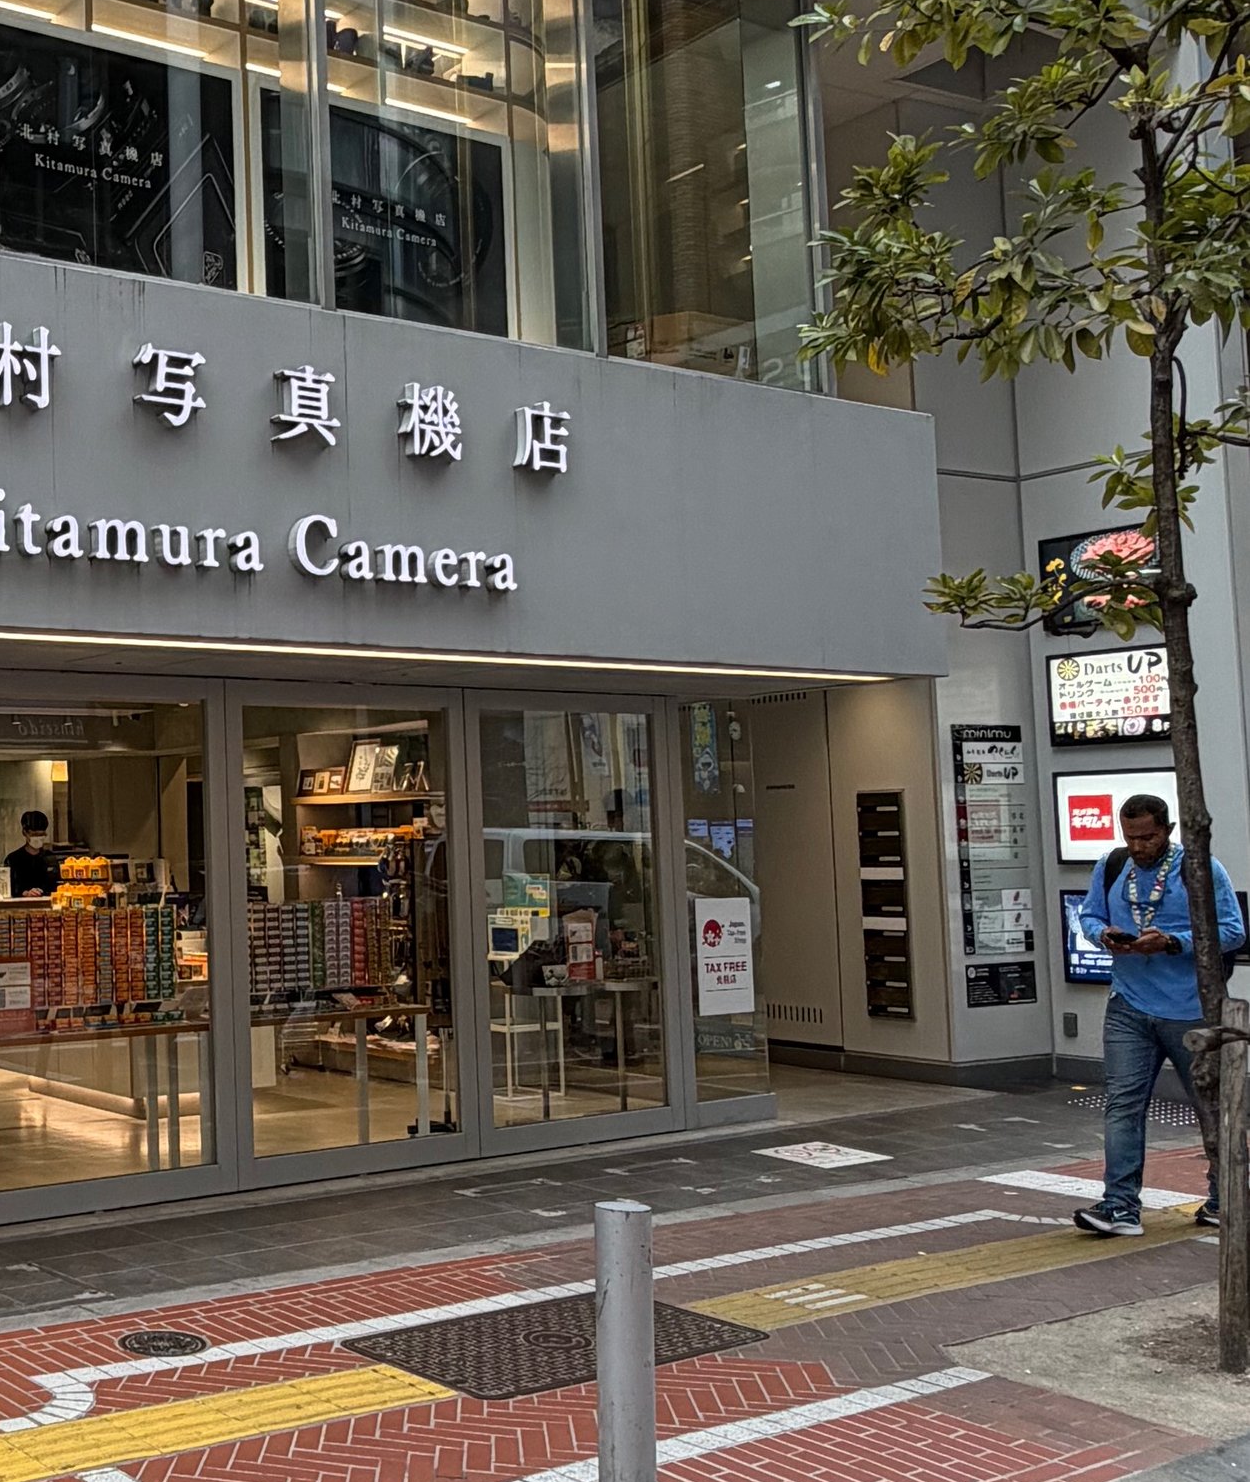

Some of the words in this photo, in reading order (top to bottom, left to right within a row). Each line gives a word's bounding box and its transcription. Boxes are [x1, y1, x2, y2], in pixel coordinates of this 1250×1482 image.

[18, 122, 164, 168] 北村写真機店
[34, 152, 98, 179] Kitamura
[102, 167, 152, 189] Camera
[341, 216, 393, 239] Kitamura
[396, 228, 437, 247] Camera
[287, 513, 519, 592] Camera
[1083, 662, 1123, 676] Darts
[1126, 651, 1163, 675] UP
[1004, 766, 1019, 780] UP
[704, 962, 722, 974] TAX
[723, 960, 748, 973] FREE
